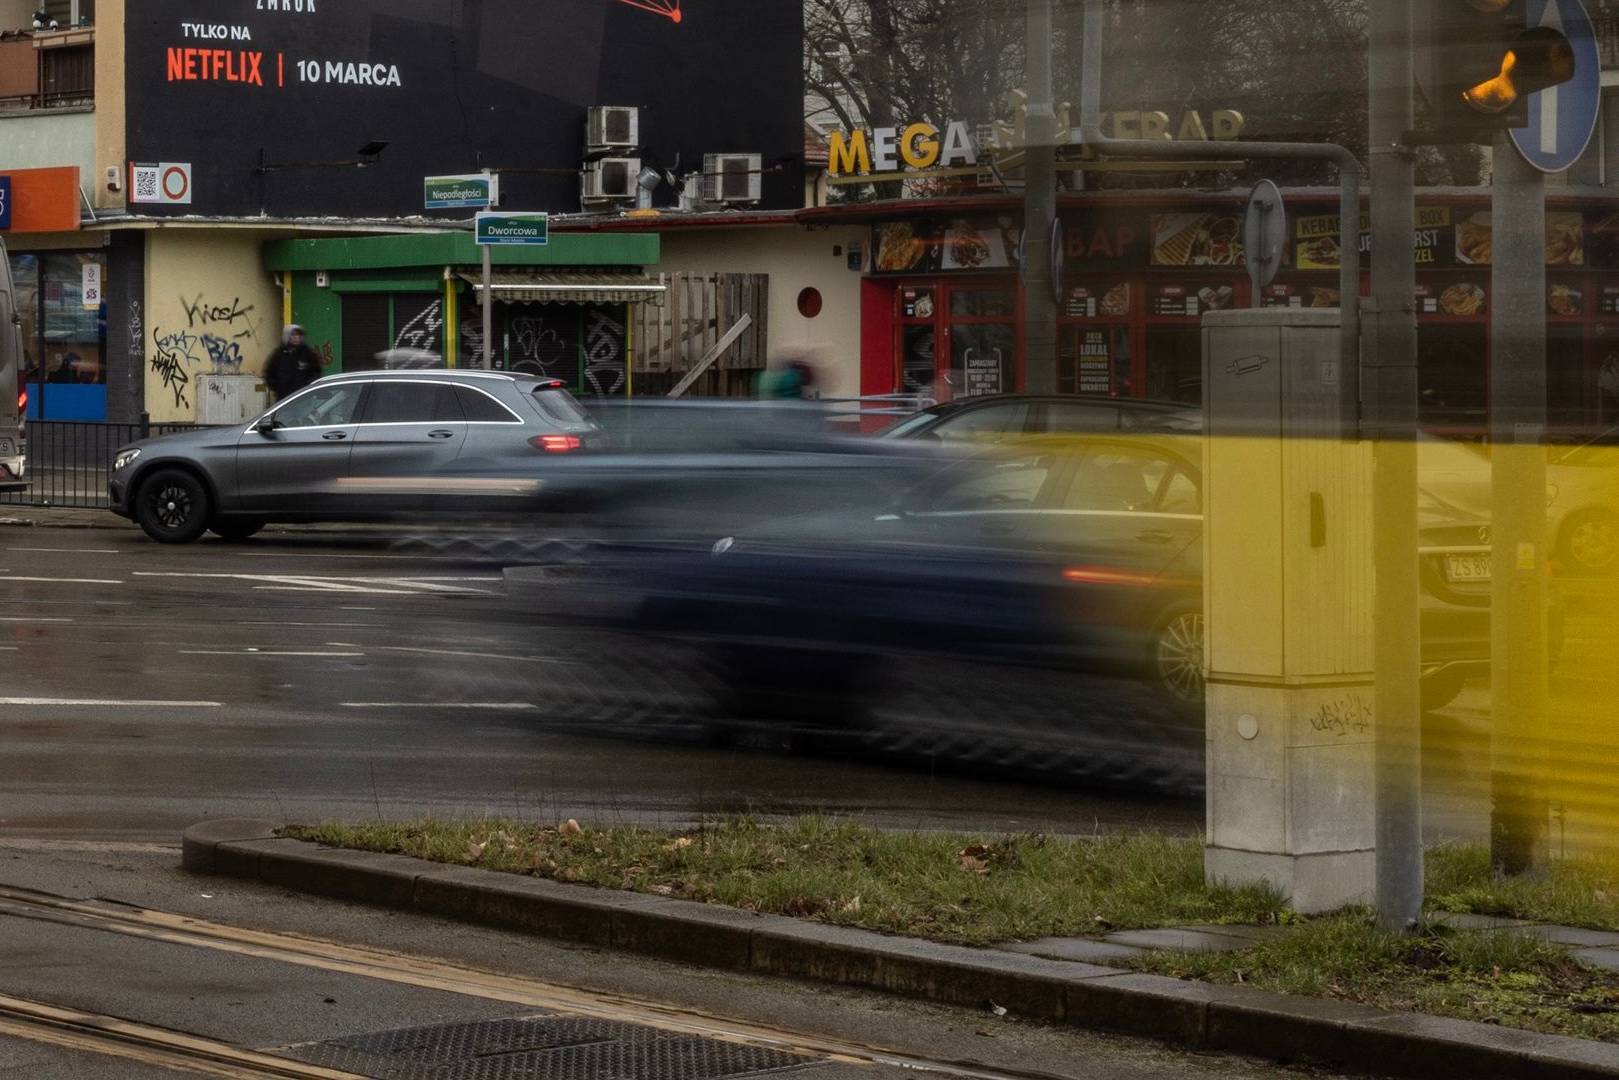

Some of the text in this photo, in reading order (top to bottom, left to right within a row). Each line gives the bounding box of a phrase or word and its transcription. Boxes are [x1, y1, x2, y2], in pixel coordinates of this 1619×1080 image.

[181, 22, 251, 41] TYLKO NA
[167, 47, 263, 87] NETFLIX
[297, 60, 402, 87] 10 MARCA
[828, 120, 977, 174] MEGA
[487, 226, 538, 236] Dworcowa
